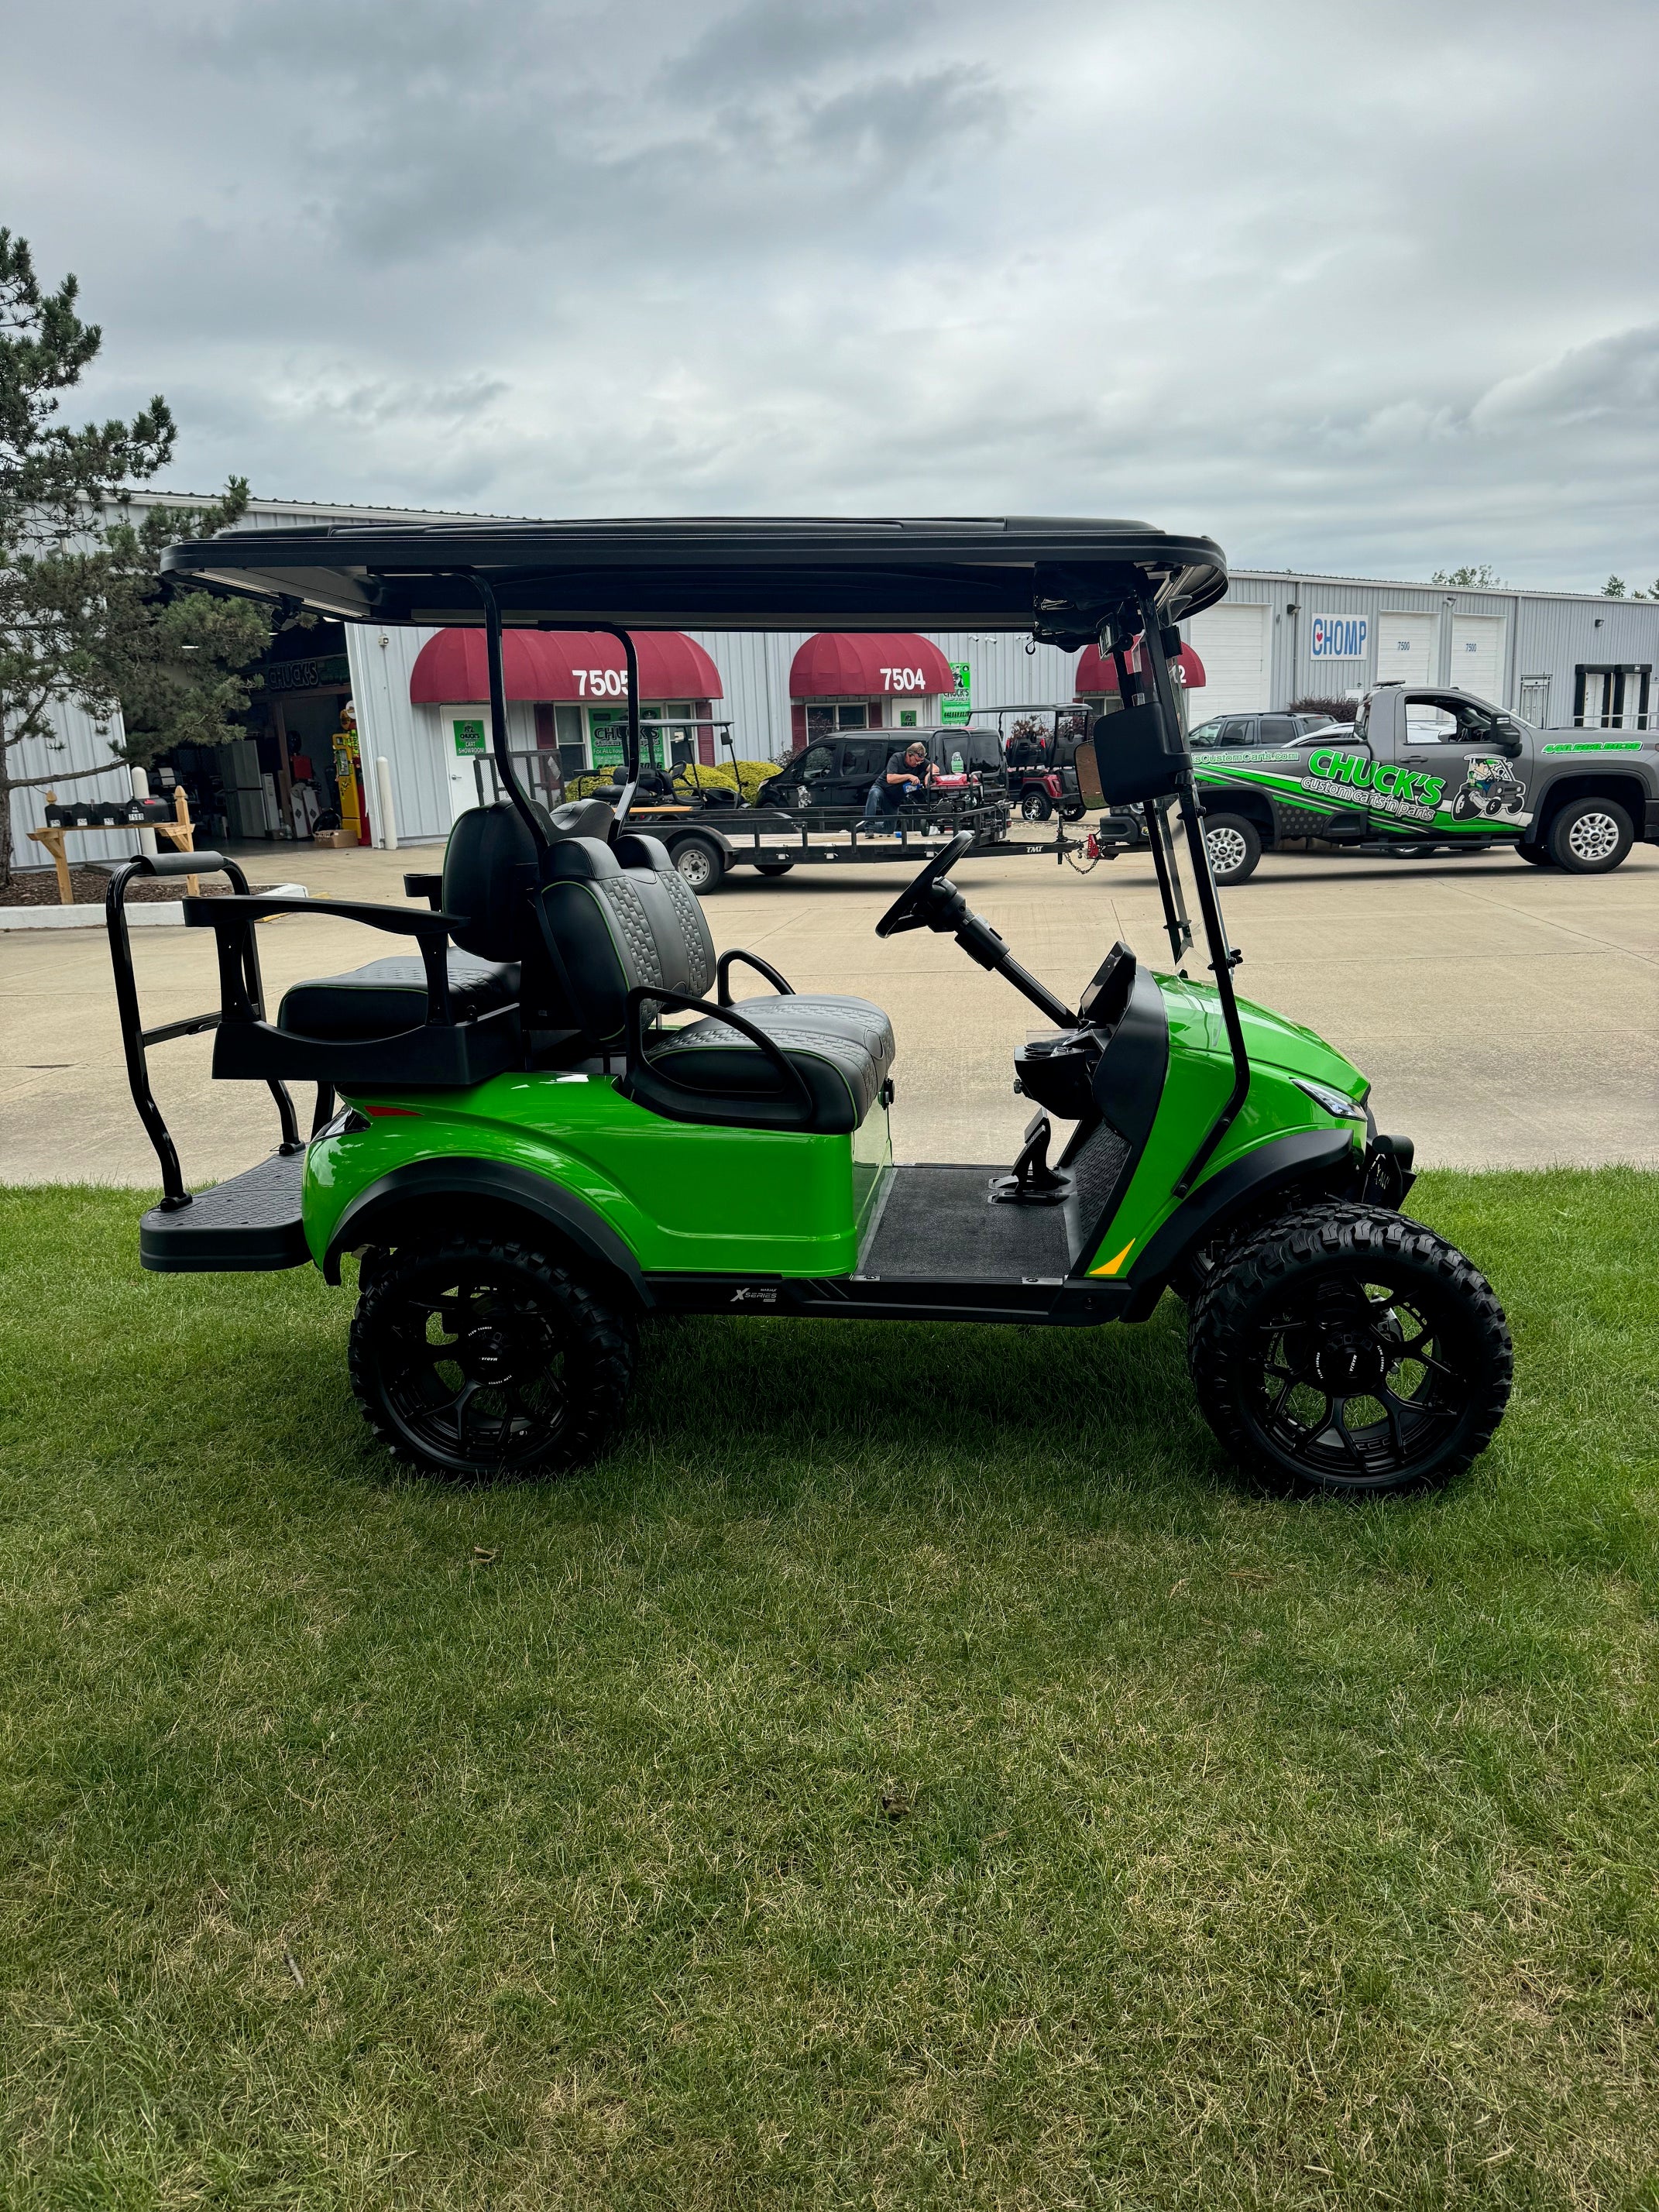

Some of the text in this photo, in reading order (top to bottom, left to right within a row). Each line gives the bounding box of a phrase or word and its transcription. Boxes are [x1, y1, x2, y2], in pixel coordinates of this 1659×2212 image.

[1312, 618, 1367, 655] CHOMP
[879, 668, 926, 691] 7504
[1309, 748, 1446, 805] CHUCK'S
[1301, 776, 1356, 801] custom
[1352, 785, 1385, 809] carts
[1396, 801, 1437, 823] parts
